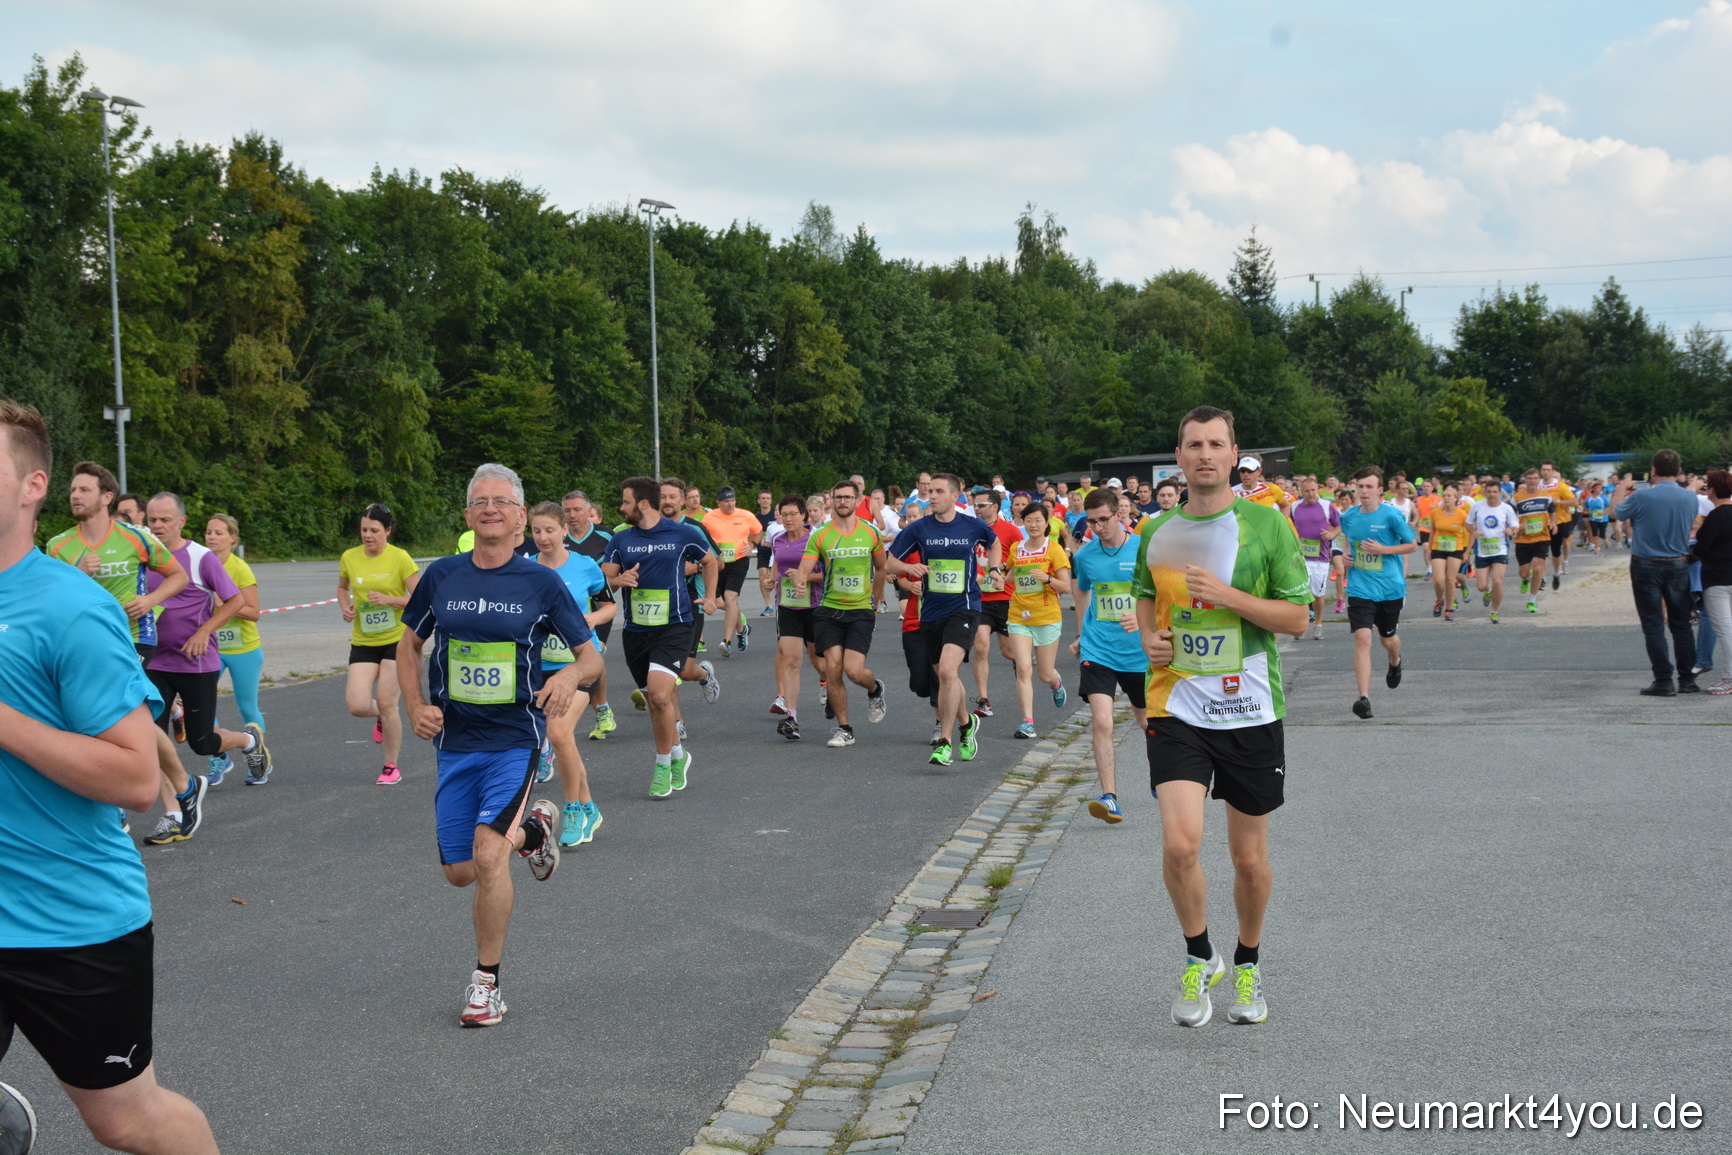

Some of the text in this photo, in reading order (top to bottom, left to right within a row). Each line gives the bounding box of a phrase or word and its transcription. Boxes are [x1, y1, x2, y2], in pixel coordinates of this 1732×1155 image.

[654, 543, 676, 552] POLES
[926, 538, 944, 546] EURO
[826, 546, 870, 560] BOCK
[1304, 545, 1316, 553] 326
[1357, 552, 1379, 563] 1107
[839, 577, 859, 587] 135
[935, 572, 957, 584] 362
[1018, 576, 1037, 587] 828
[785, 588, 804, 599] 32
[446, 600, 523, 614] EURO POLES
[1100, 596, 1132, 610] 1101
[637, 604, 661, 616] 377
[365, 611, 389, 625] 652
[1182, 633, 1226, 657] 997
[460, 666, 501, 687] 368
[1210, 695, 1253, 706] Neumarkter
[1202, 703, 1261, 716] Lammsbräu
